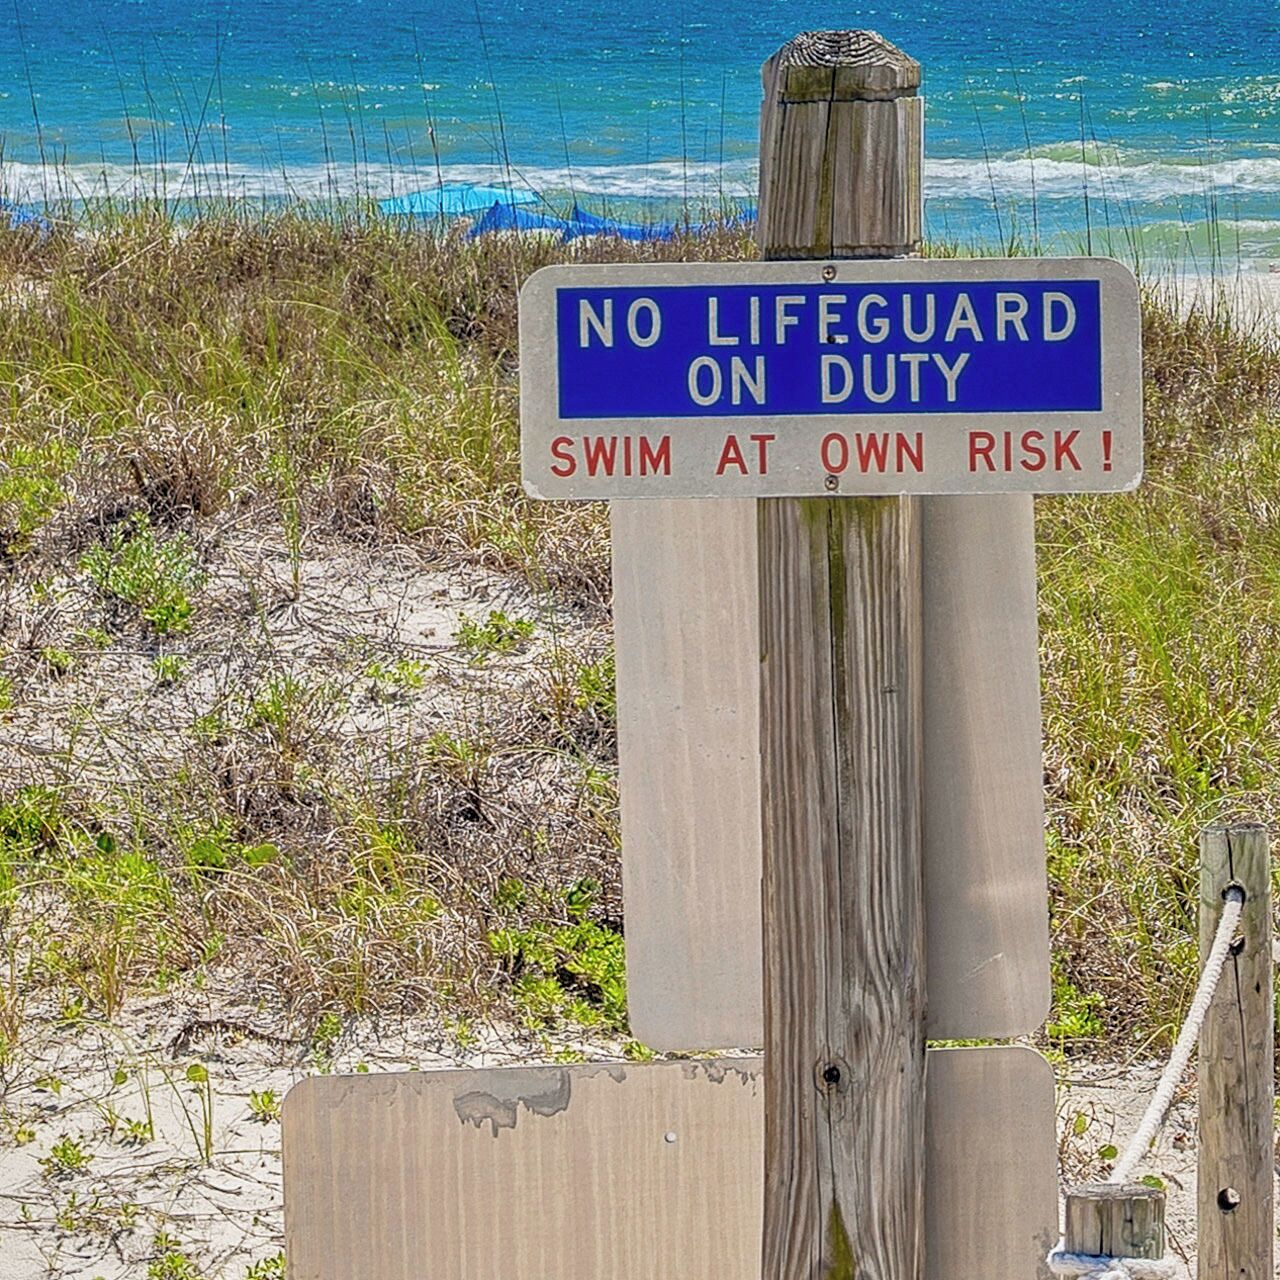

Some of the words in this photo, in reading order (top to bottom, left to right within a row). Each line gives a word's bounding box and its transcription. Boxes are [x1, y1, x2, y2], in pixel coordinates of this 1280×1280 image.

[578, 296, 663, 349] NO
[707, 291, 1078, 347] LIFEGUARD
[687, 354, 767, 407] ON
[819, 351, 971, 405] DUTY
[549, 434, 673, 478] SWIM
[714, 433, 776, 476] AT
[819, 431, 925, 475] OWN
